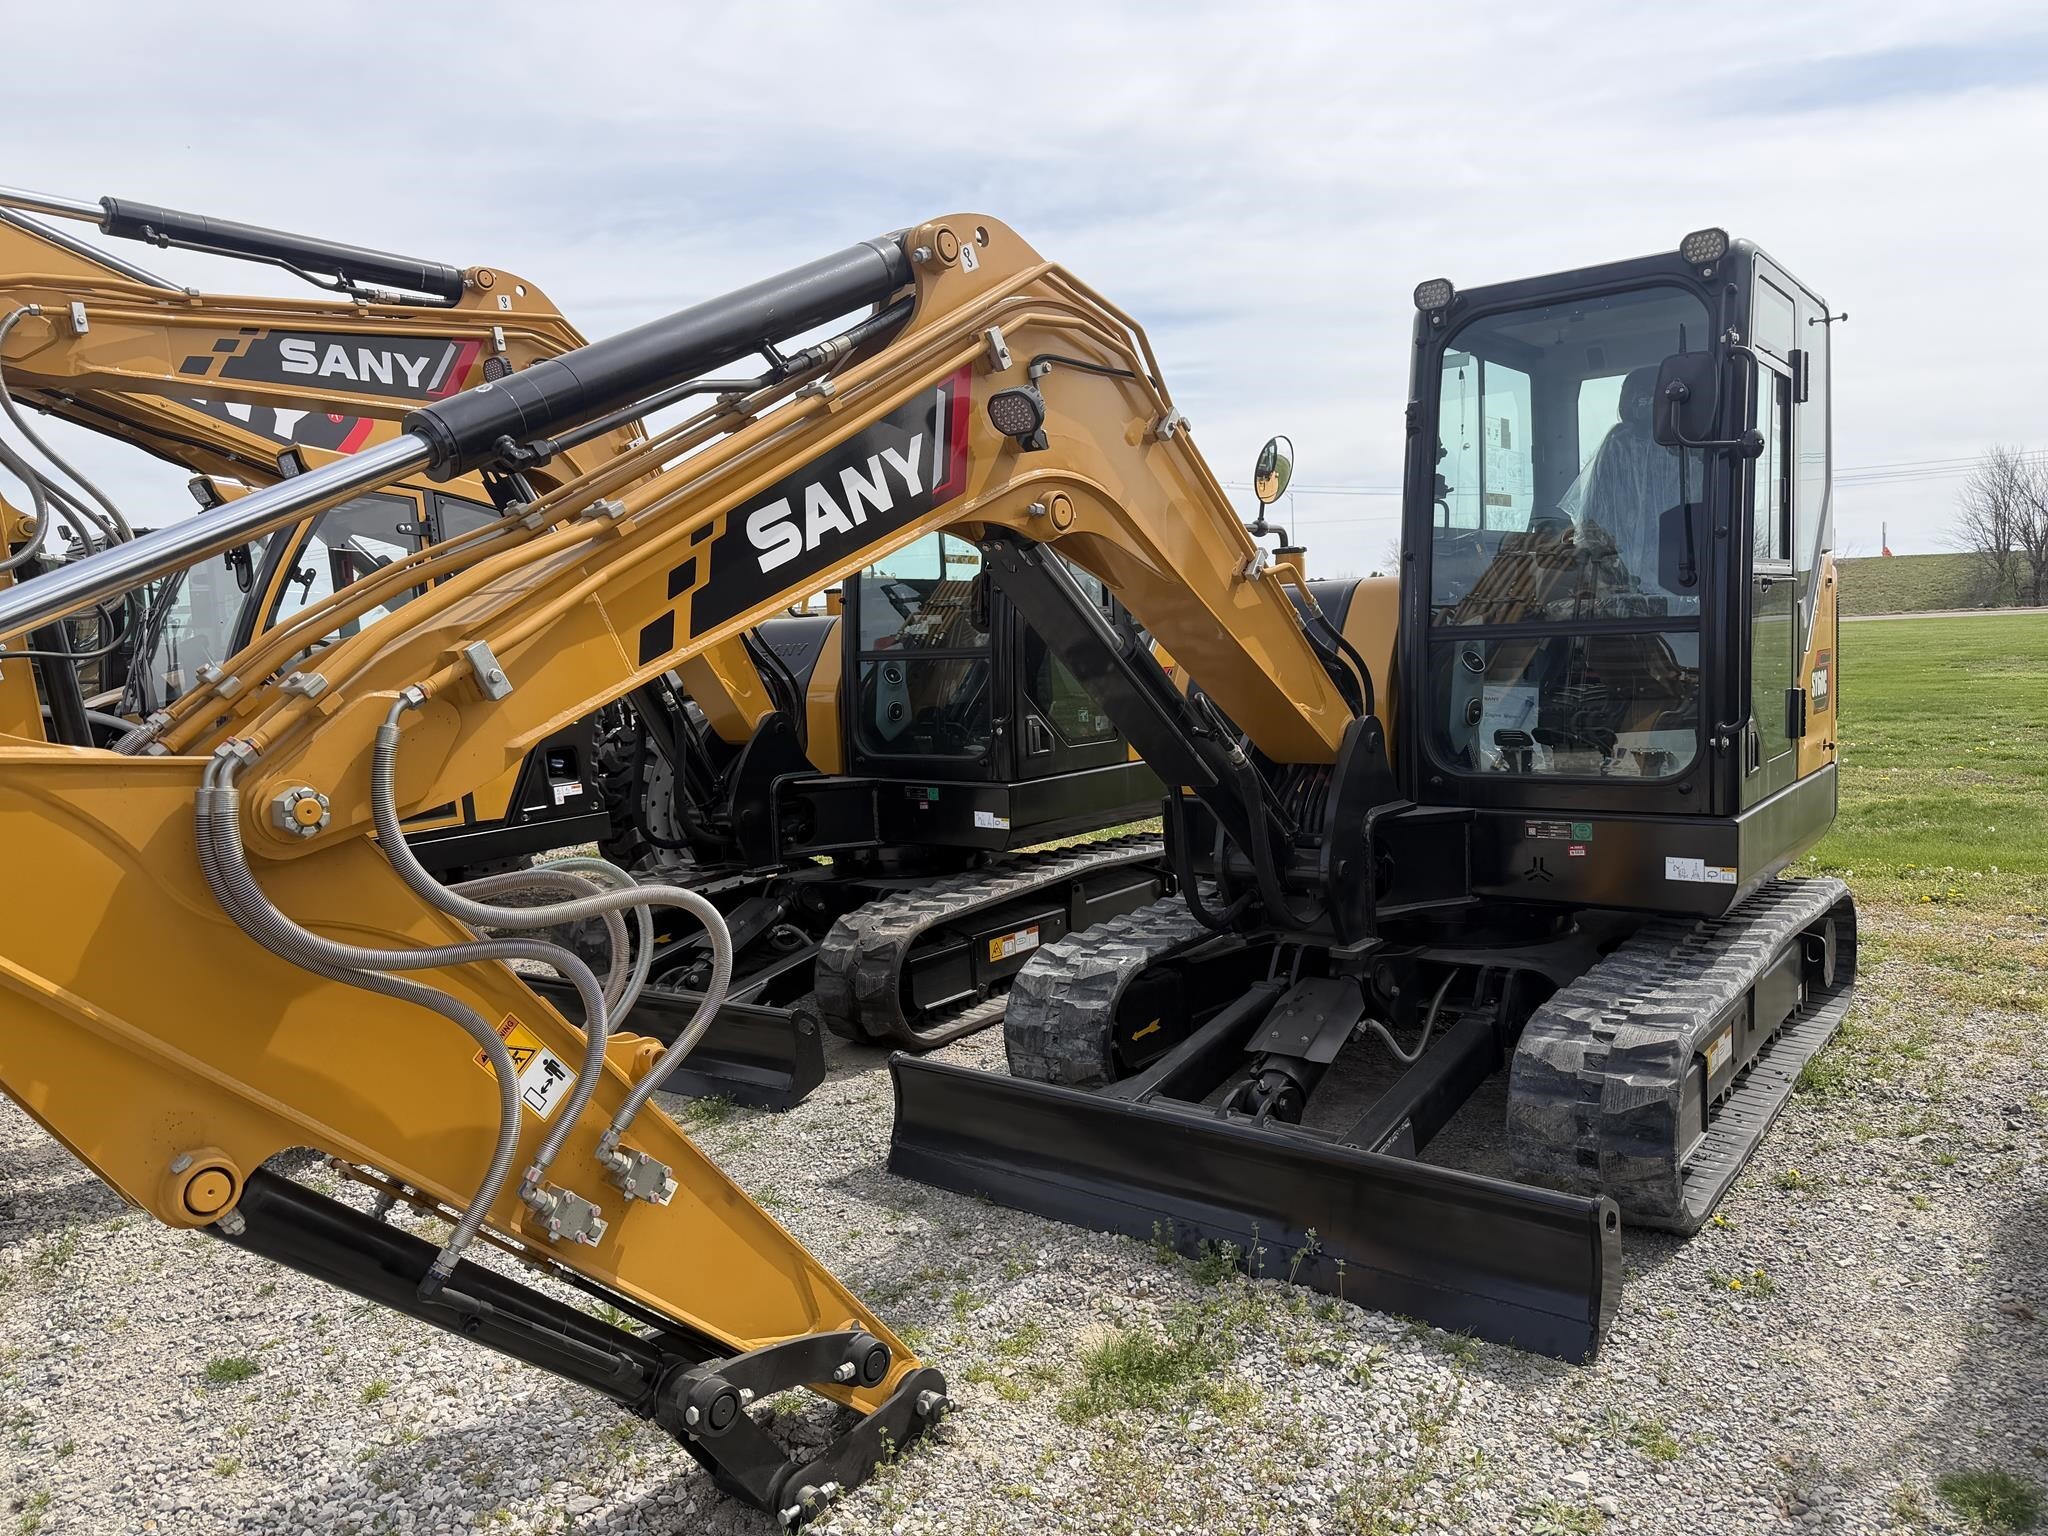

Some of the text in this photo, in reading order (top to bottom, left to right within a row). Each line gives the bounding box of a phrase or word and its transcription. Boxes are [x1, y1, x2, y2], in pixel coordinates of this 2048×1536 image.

[279, 338, 430, 388] SANY
[746, 433, 924, 574] SANY
[499, 1020, 514, 1039] NING
